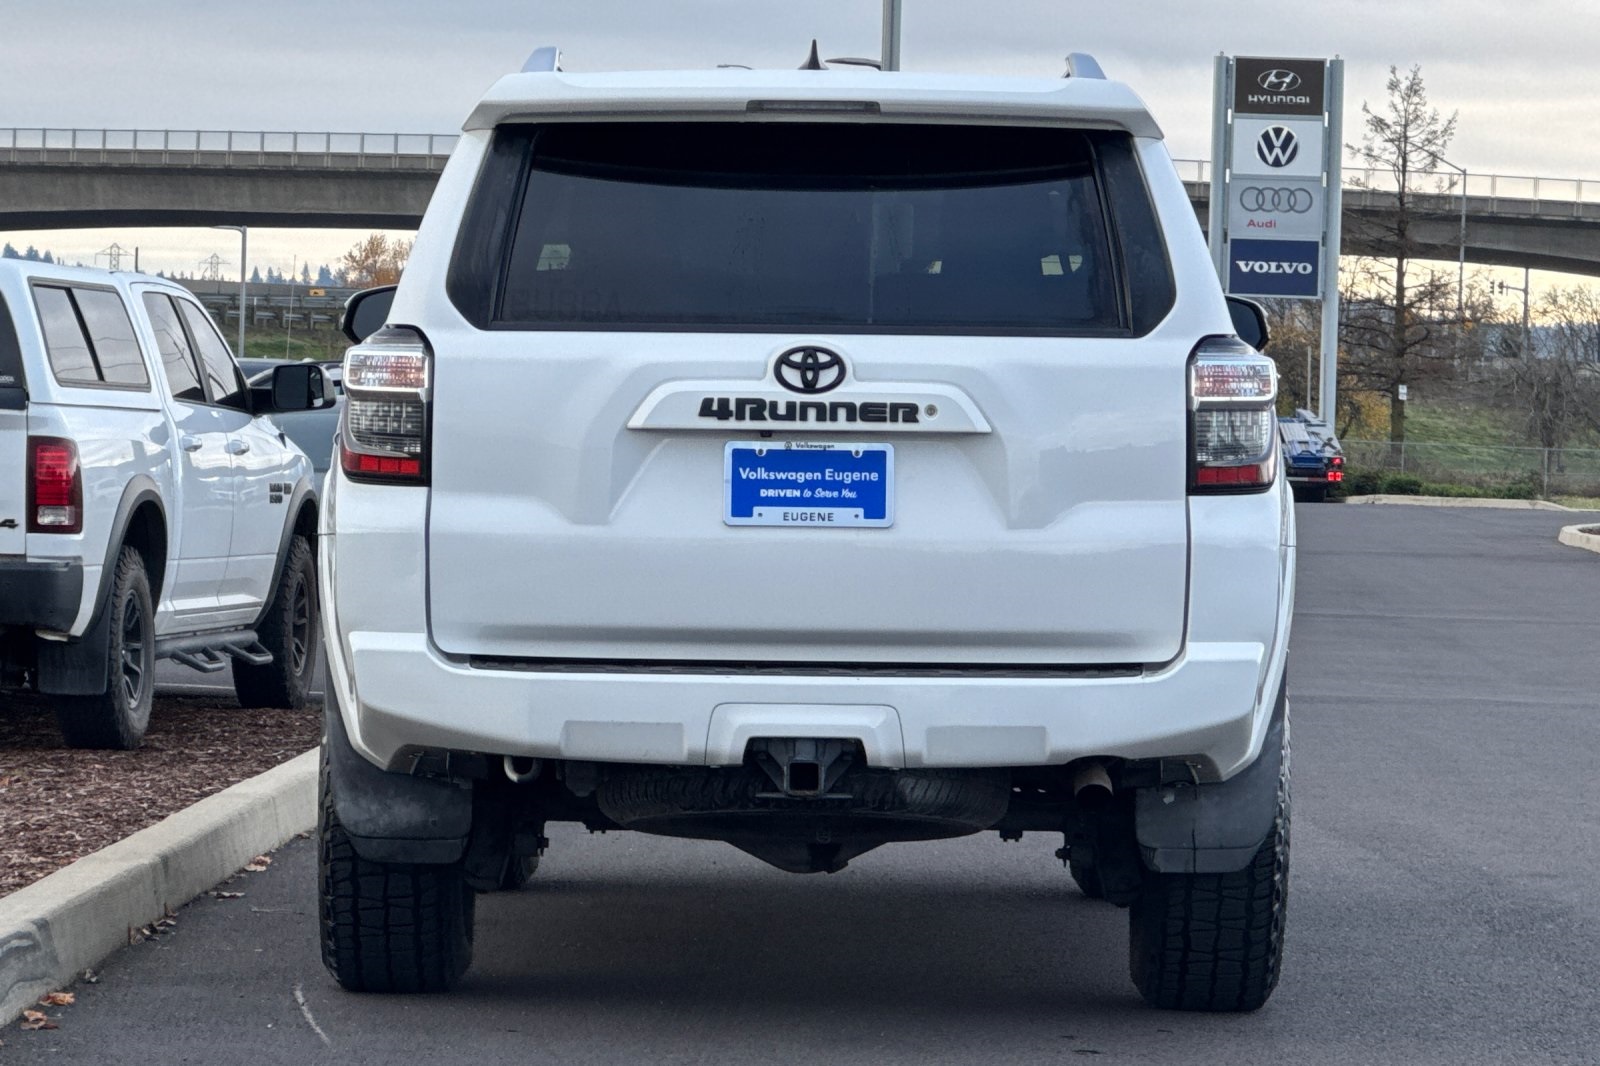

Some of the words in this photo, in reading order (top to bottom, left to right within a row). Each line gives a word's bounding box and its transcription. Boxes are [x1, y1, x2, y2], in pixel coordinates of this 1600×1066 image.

[1248, 94, 1310, 104] HYUNDAI
[1247, 219, 1277, 229] Audi
[1236, 261, 1313, 274] VOLVO
[698, 397, 920, 423] 4RUNNER
[739, 467, 821, 483] Volkswagen
[825, 468, 879, 484] Eugene
[760, 488, 801, 498] DRIVEN
[802, 488, 812, 498] to
[814, 487, 839, 498] Serve
[783, 512, 835, 522] EUGENE
